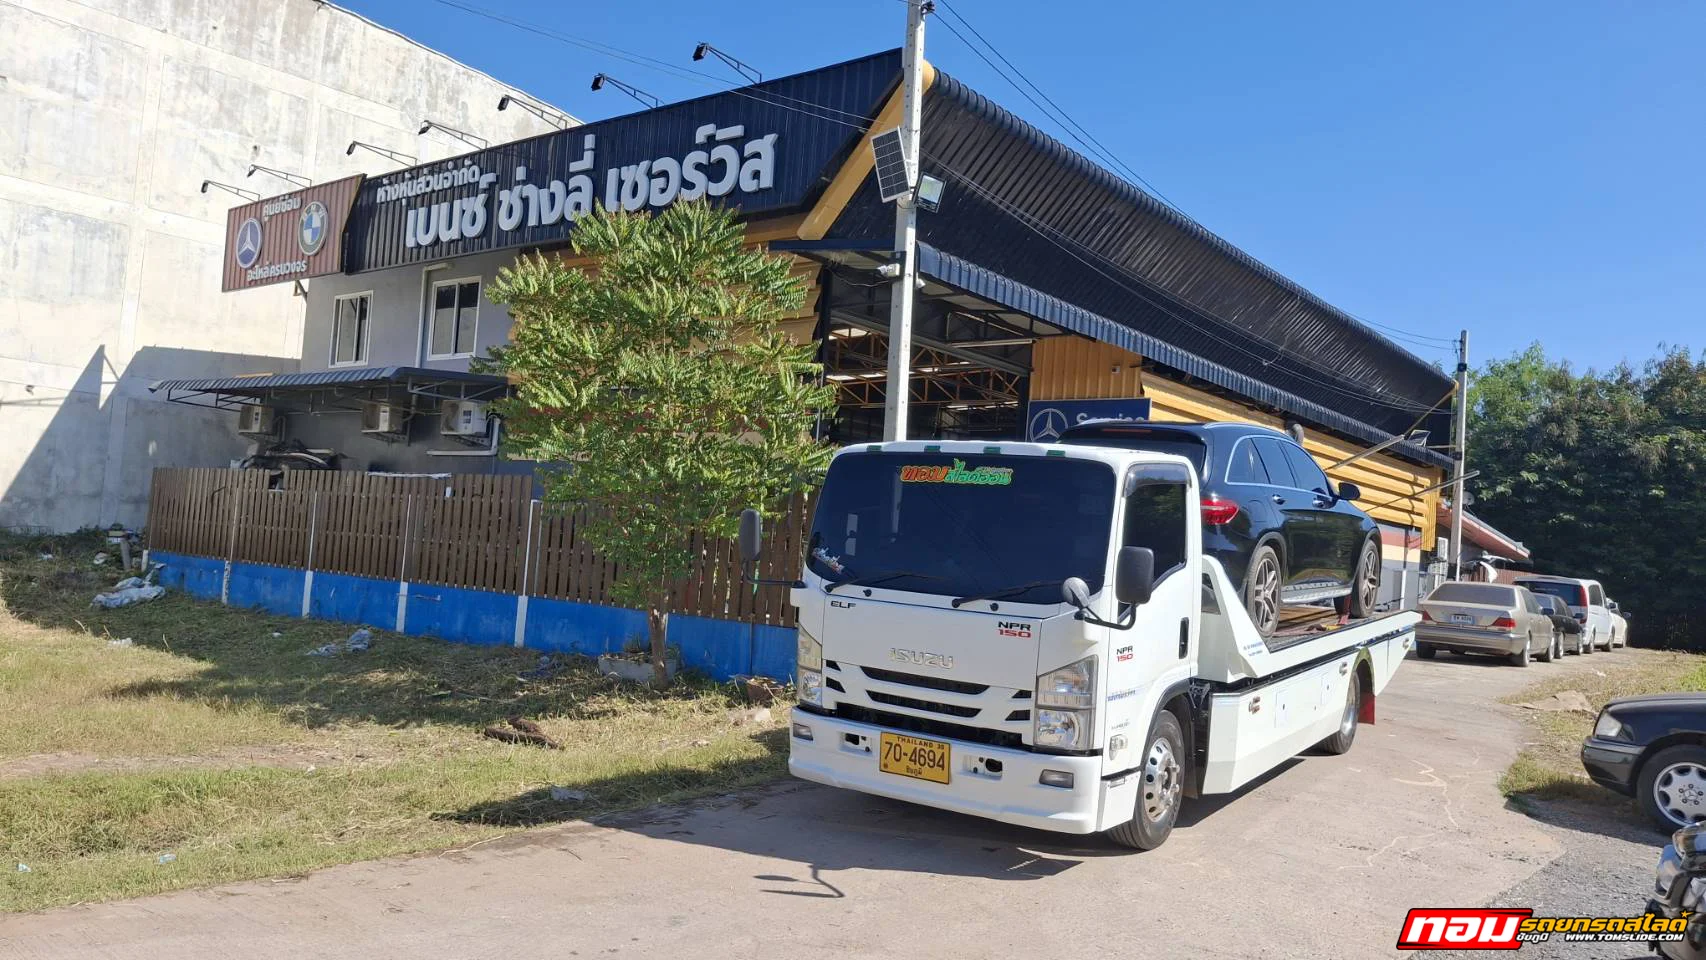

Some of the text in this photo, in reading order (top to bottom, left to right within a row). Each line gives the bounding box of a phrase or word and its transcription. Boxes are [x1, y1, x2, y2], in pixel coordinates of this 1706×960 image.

[376, 160, 480, 206] ห้างหุ้นส่วนจำกัด
[405, 123, 779, 248] เบนซ์ ช่างลี่ เซอร์วิส
[998, 621, 1031, 631] NPR
[998, 629, 1031, 638] 150
[1116, 645, 1133, 655] NPR
[889, 648, 953, 669] ISUZU
[1117, 653, 1133, 662] 150
[897, 736, 933, 748] THAILAND
[884, 741, 945, 771] 70-4694
